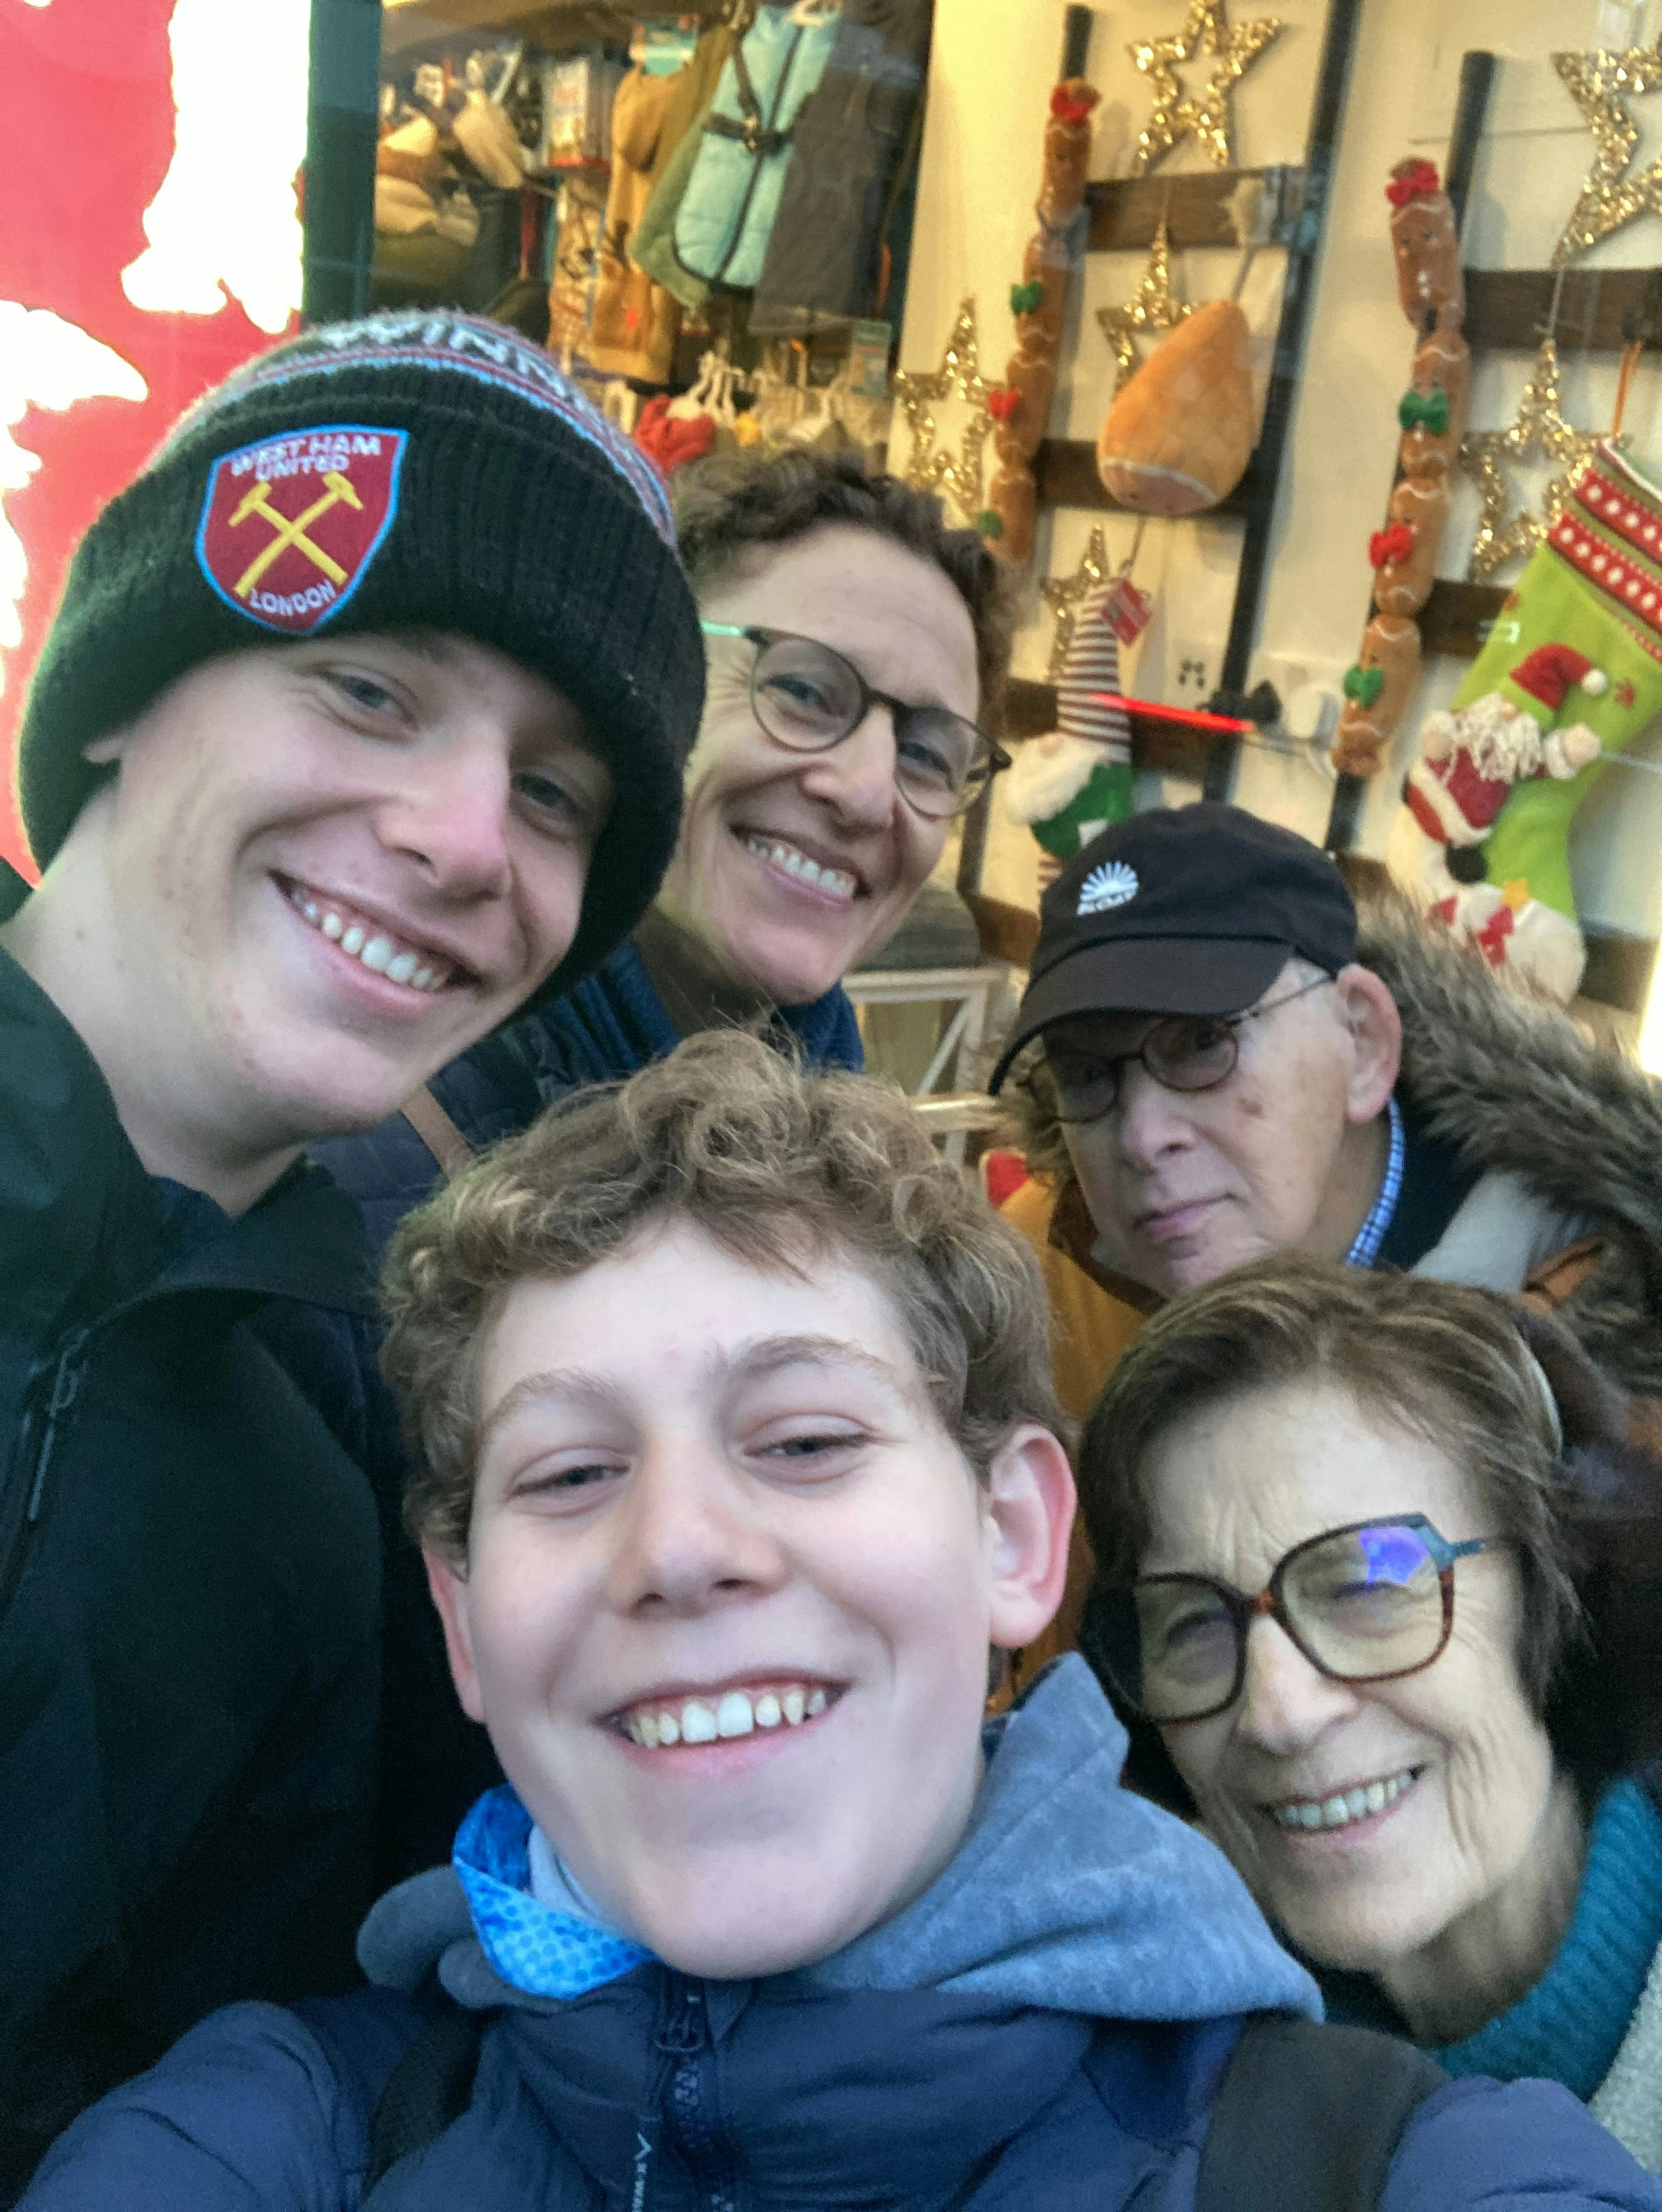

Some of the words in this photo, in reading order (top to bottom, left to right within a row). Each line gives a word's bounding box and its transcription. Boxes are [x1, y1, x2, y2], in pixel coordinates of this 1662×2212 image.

[231, 438, 307, 476] WEST
[308, 434, 382, 456] HAM
[255, 453, 350, 481] UNITED
[249, 577, 337, 617] LONDON
